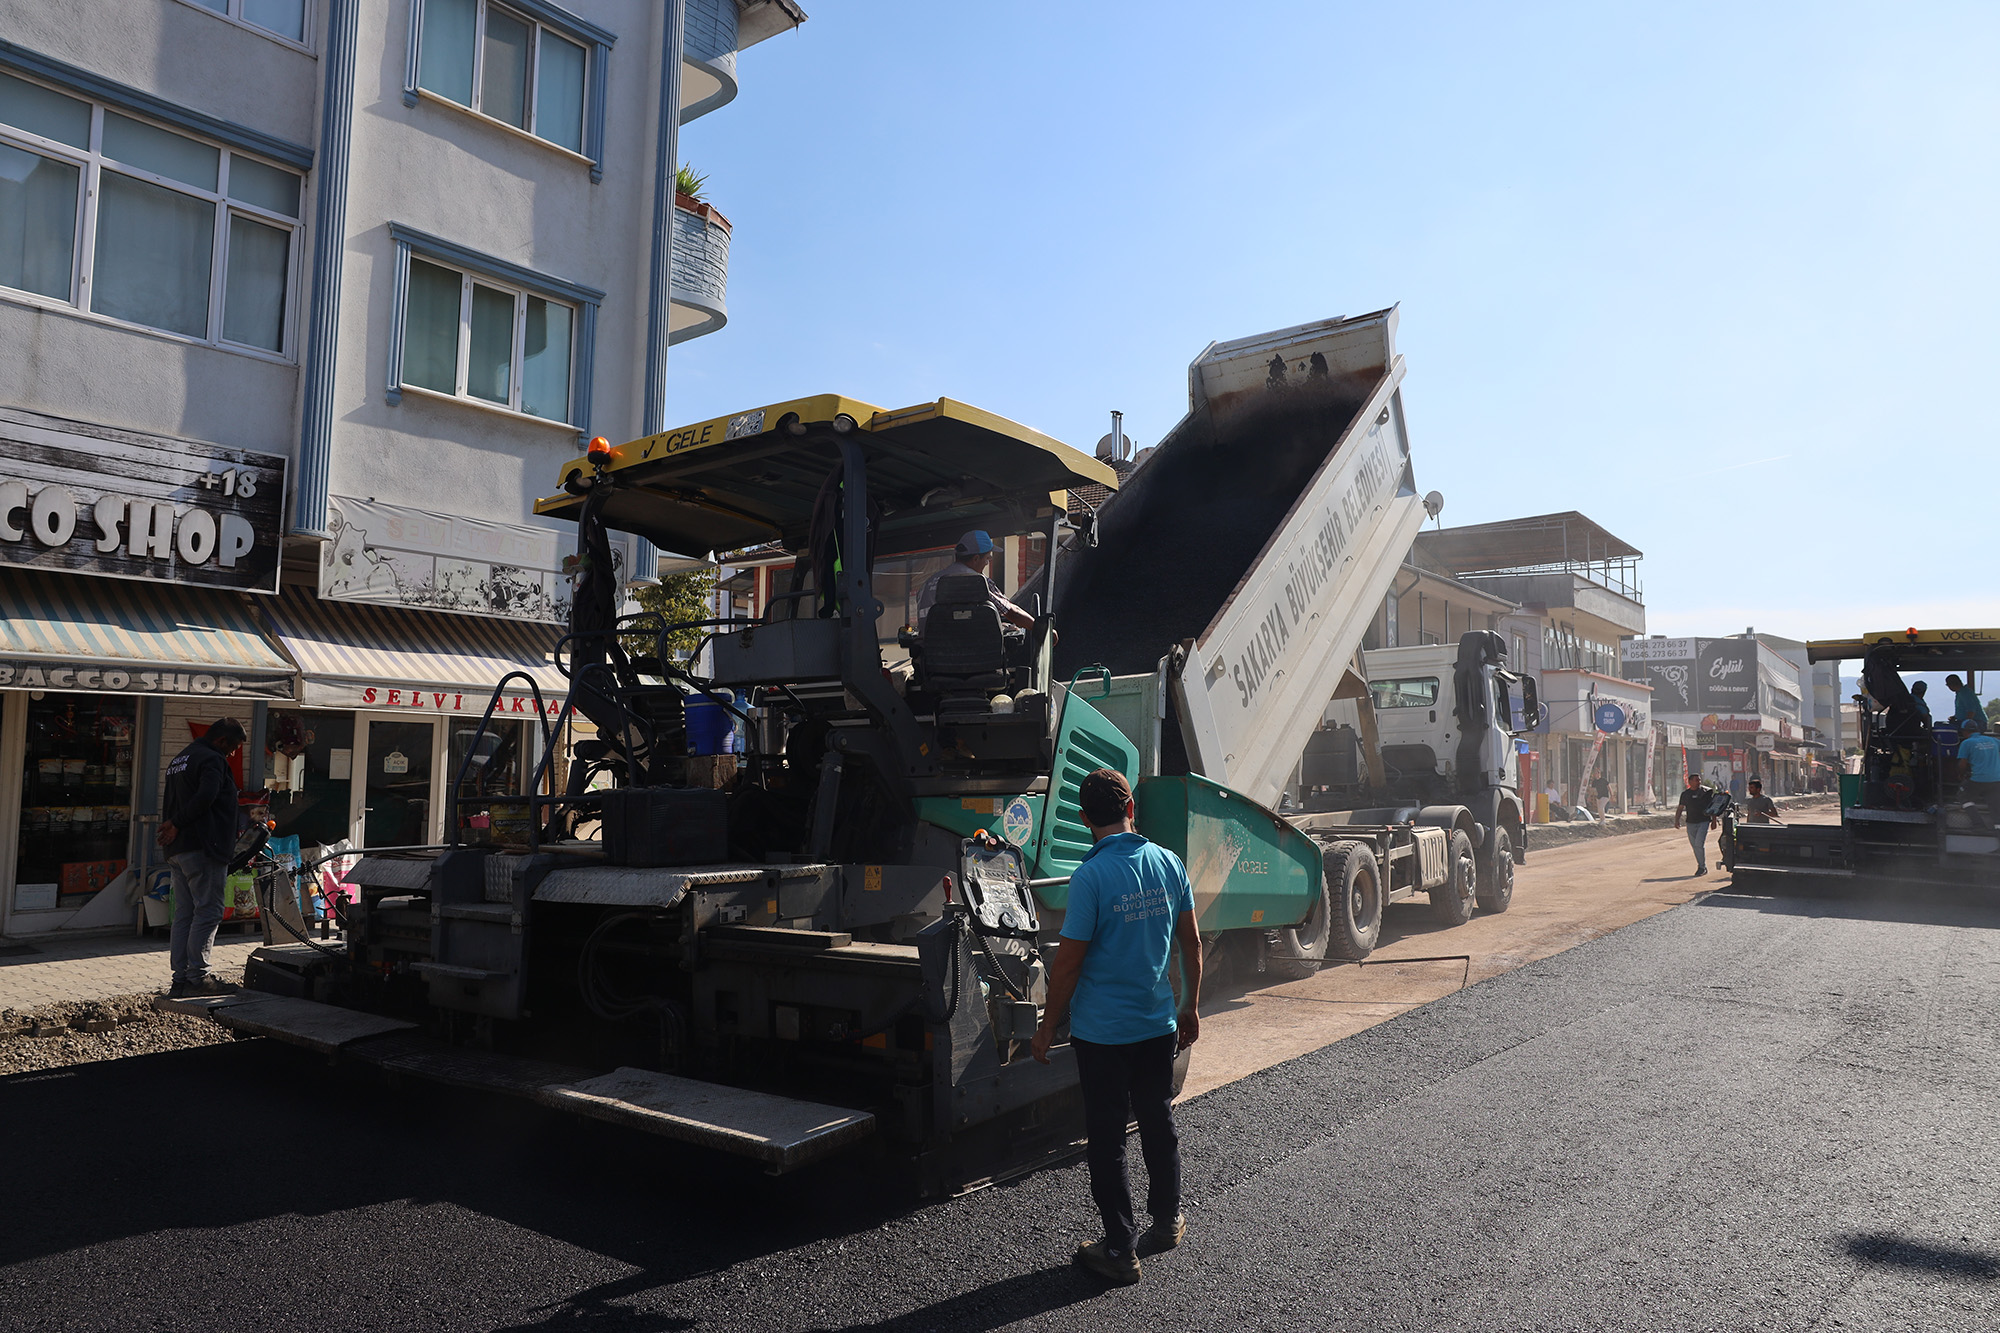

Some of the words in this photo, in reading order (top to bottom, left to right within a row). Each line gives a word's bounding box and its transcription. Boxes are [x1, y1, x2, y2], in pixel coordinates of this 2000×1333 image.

[641, 425, 713, 459] VGELE
[200, 467, 258, 498] +18
[93, 494, 255, 568] SHOP
[1233, 602, 1289, 708] SAKARYA
[1285, 507, 1346, 626] BÜYÜKŞEHİR
[1342, 436, 1389, 535] BELEDİYESİ
[1652, 641, 1666, 649] 273
[1667, 640, 1677, 648] 66
[1652, 650, 1666, 658] 273
[1678, 649, 1688, 657] 37
[0, 663, 131, 690] BACCO
[140, 672, 242, 695] SHOP
[1709, 656, 1744, 680] Eylül
[362, 687, 463, 710] SELVİ
[1709, 684, 1728, 692] DÜĞÜN
[1237, 857, 1269, 875] VÖGELE
[1113, 893, 1173, 913] BÜYÜŞEHR
[1124, 905, 1168, 923] BELEİYESİ
